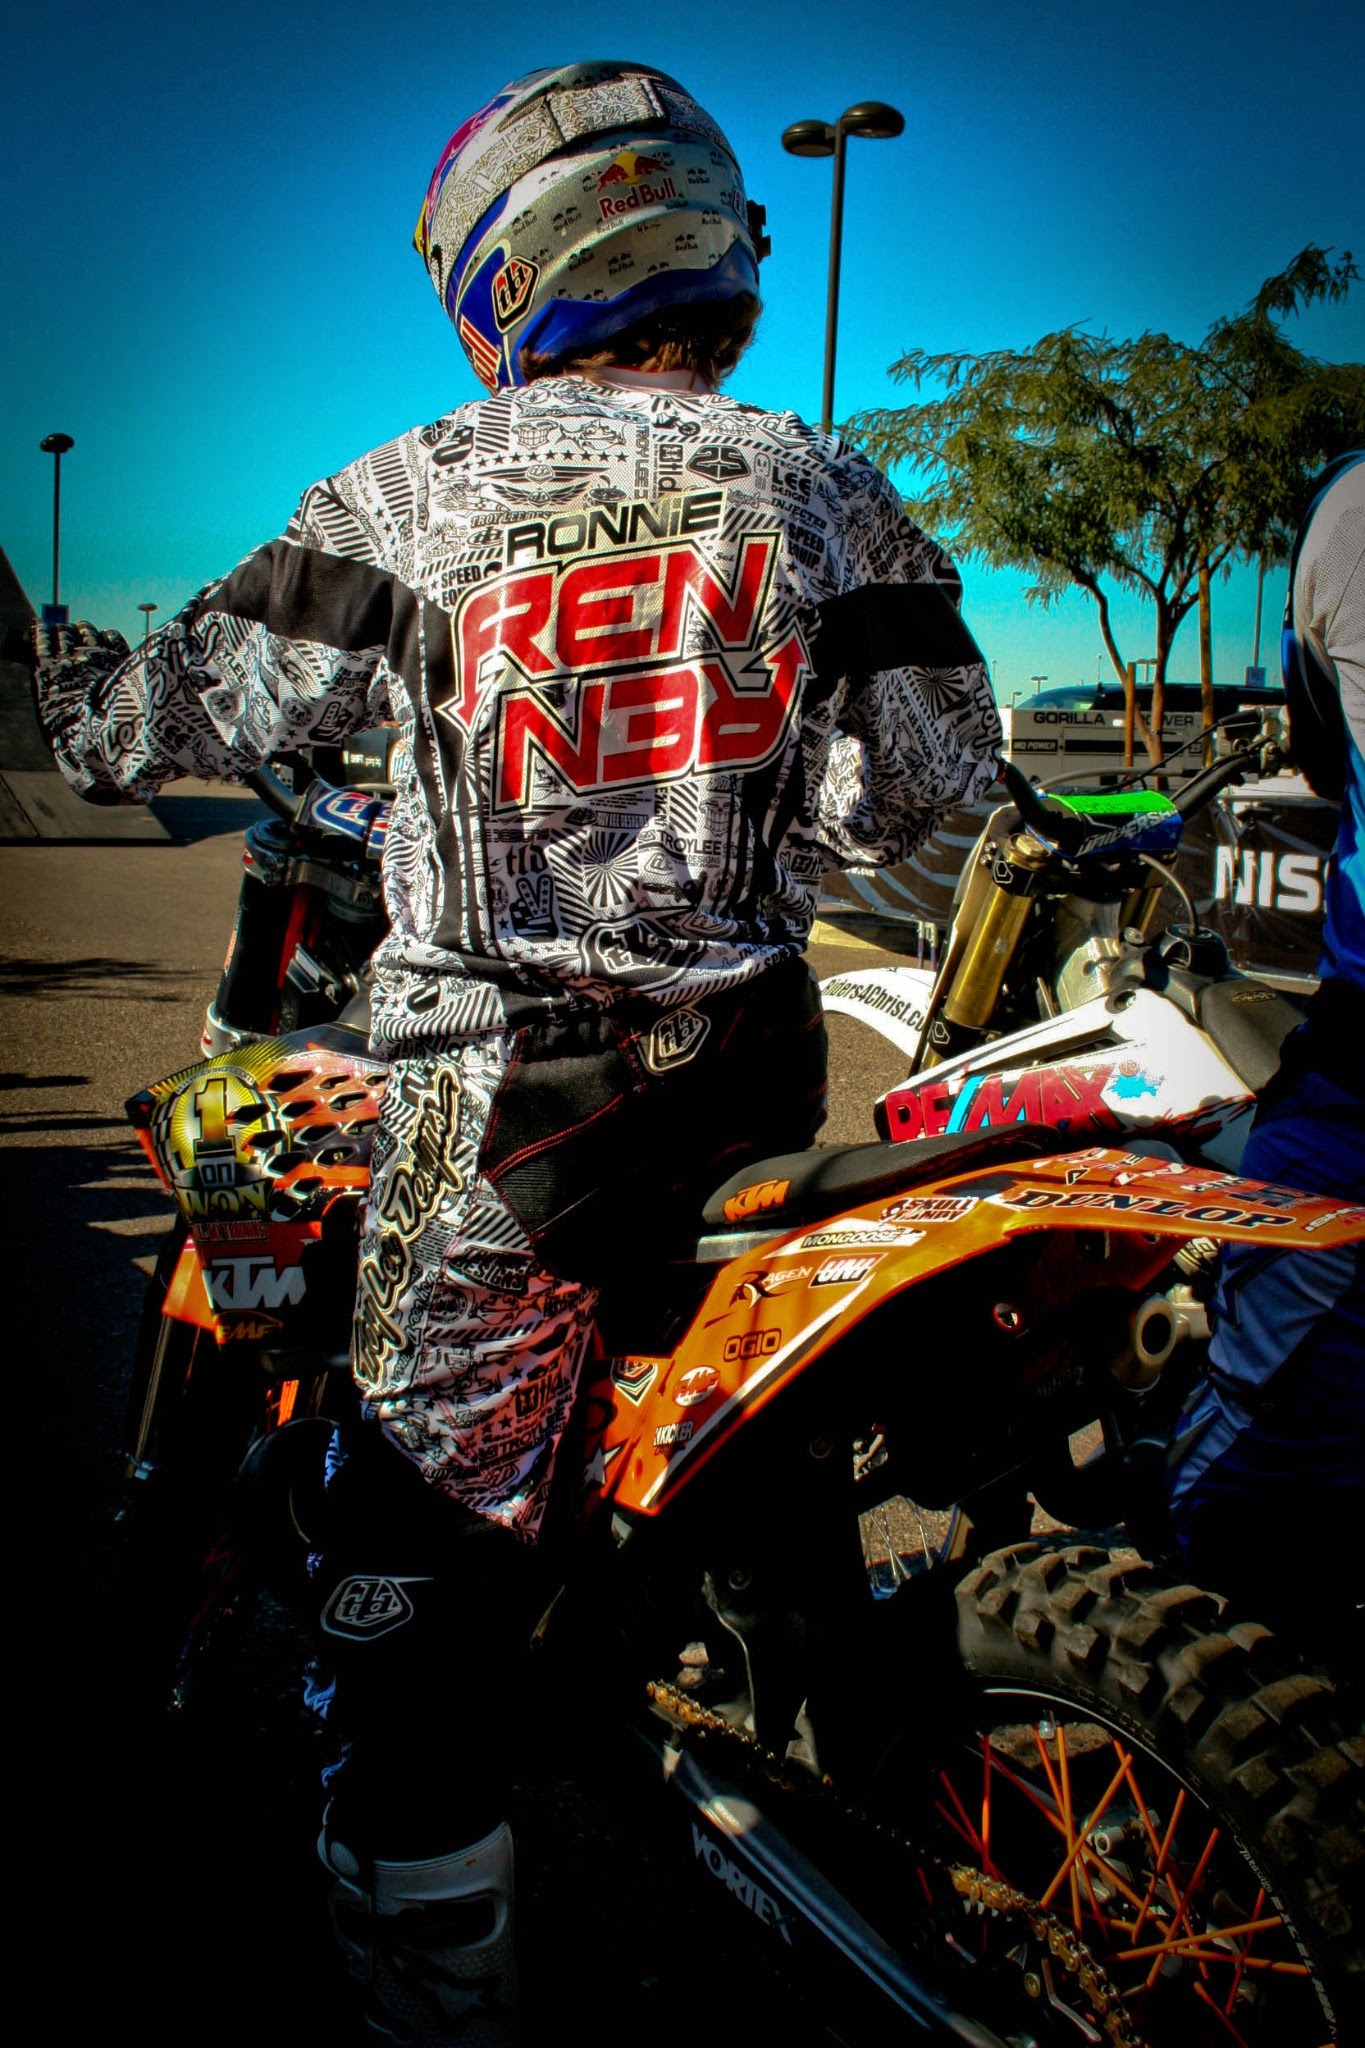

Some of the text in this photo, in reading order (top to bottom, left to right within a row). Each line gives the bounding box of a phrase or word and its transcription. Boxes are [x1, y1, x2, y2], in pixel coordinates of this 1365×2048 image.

[599, 178, 677, 219] Red Bull
[772, 466, 812, 497] LEE
[788, 522, 826, 553] SPEED
[441, 565, 481, 588] SPEED
[154, 714, 192, 749] LEE
[1034, 712, 1105, 725] GORILLA
[1028, 741, 1056, 750] POWER
[688, 855, 721, 865] DESIGNS
[1215, 845, 1327, 912] NIS
[194, 1079, 236, 1153] 1
[379, 1066, 462, 1240] Designs
[201, 1162, 232, 1186] on
[180, 1180, 267, 1219] WON
[724, 1179, 791, 1223] KTM
[1005, 1189, 1297, 1229] DUNLOP
[801, 1230, 899, 1249] MONGOOSE
[202, 1256, 307, 1309] KTM
[816, 1257, 880, 1283] UNI
[723, 1328, 782, 1362] OGIO
[691, 1821, 793, 1946] VORTEX
